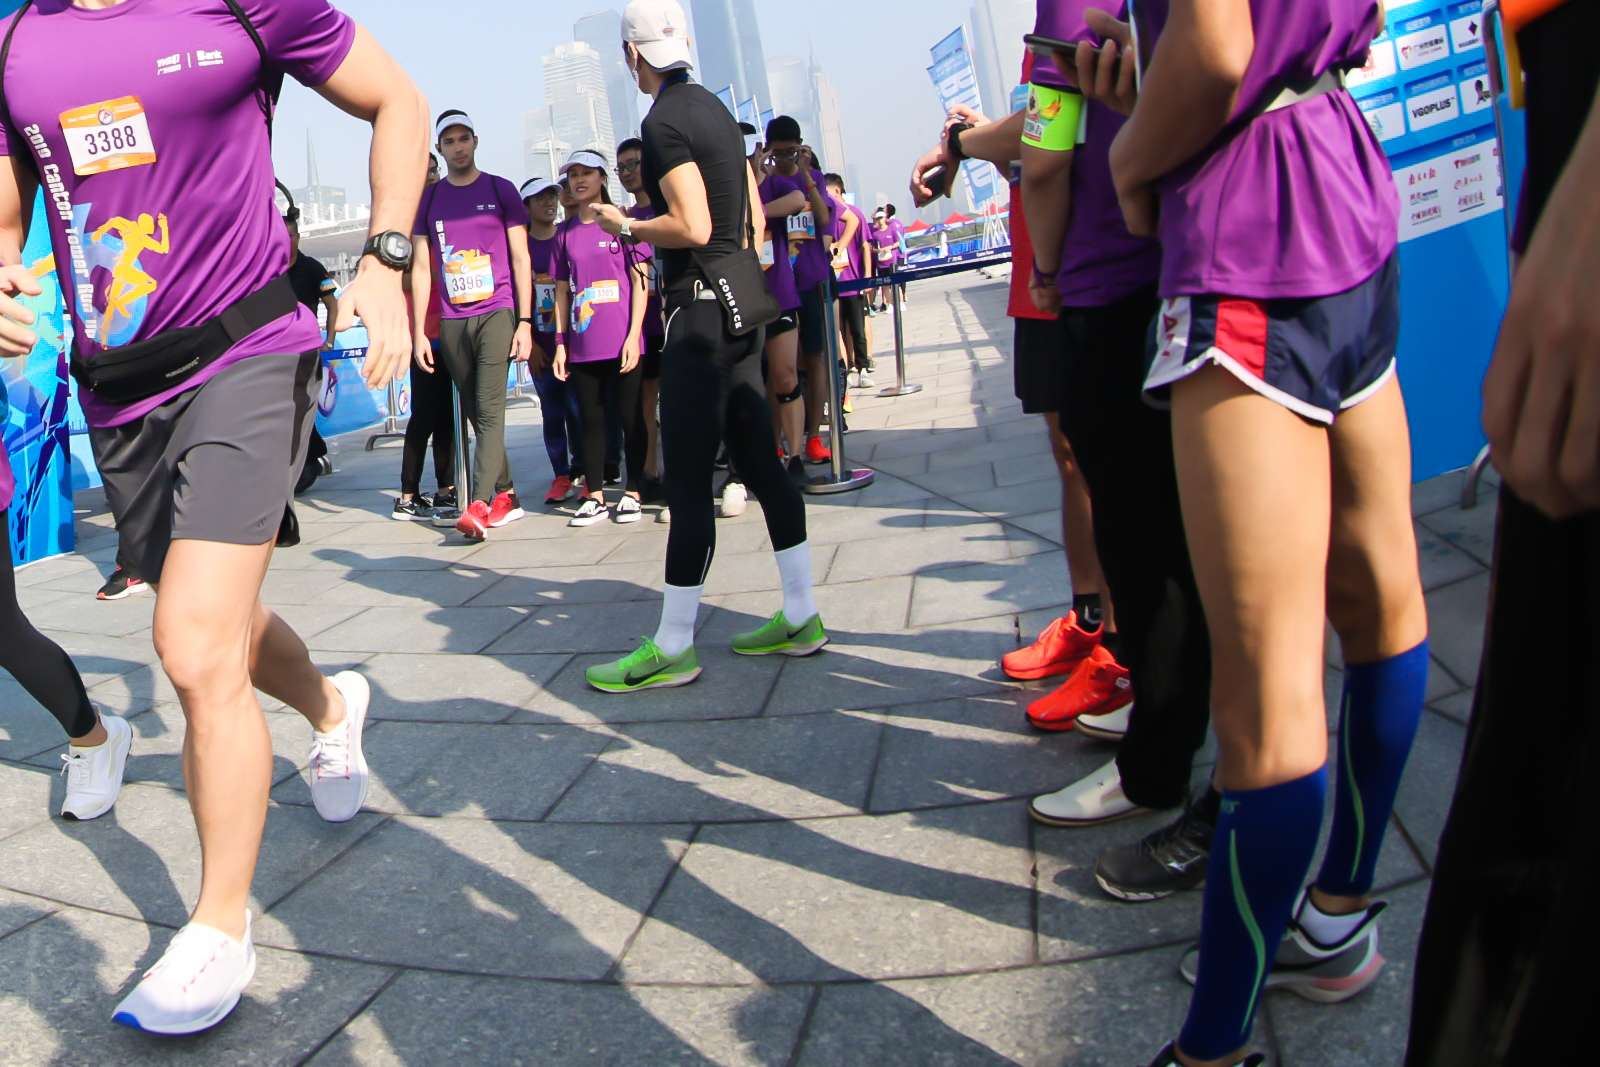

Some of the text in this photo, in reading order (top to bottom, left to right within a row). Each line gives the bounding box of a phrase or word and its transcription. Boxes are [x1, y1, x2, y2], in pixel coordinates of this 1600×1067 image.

[84, 125, 137, 155] 3388
[43, 163, 75, 222] Canton
[452, 274, 483, 292] 3396
[719, 278, 743, 330] COMBACK
